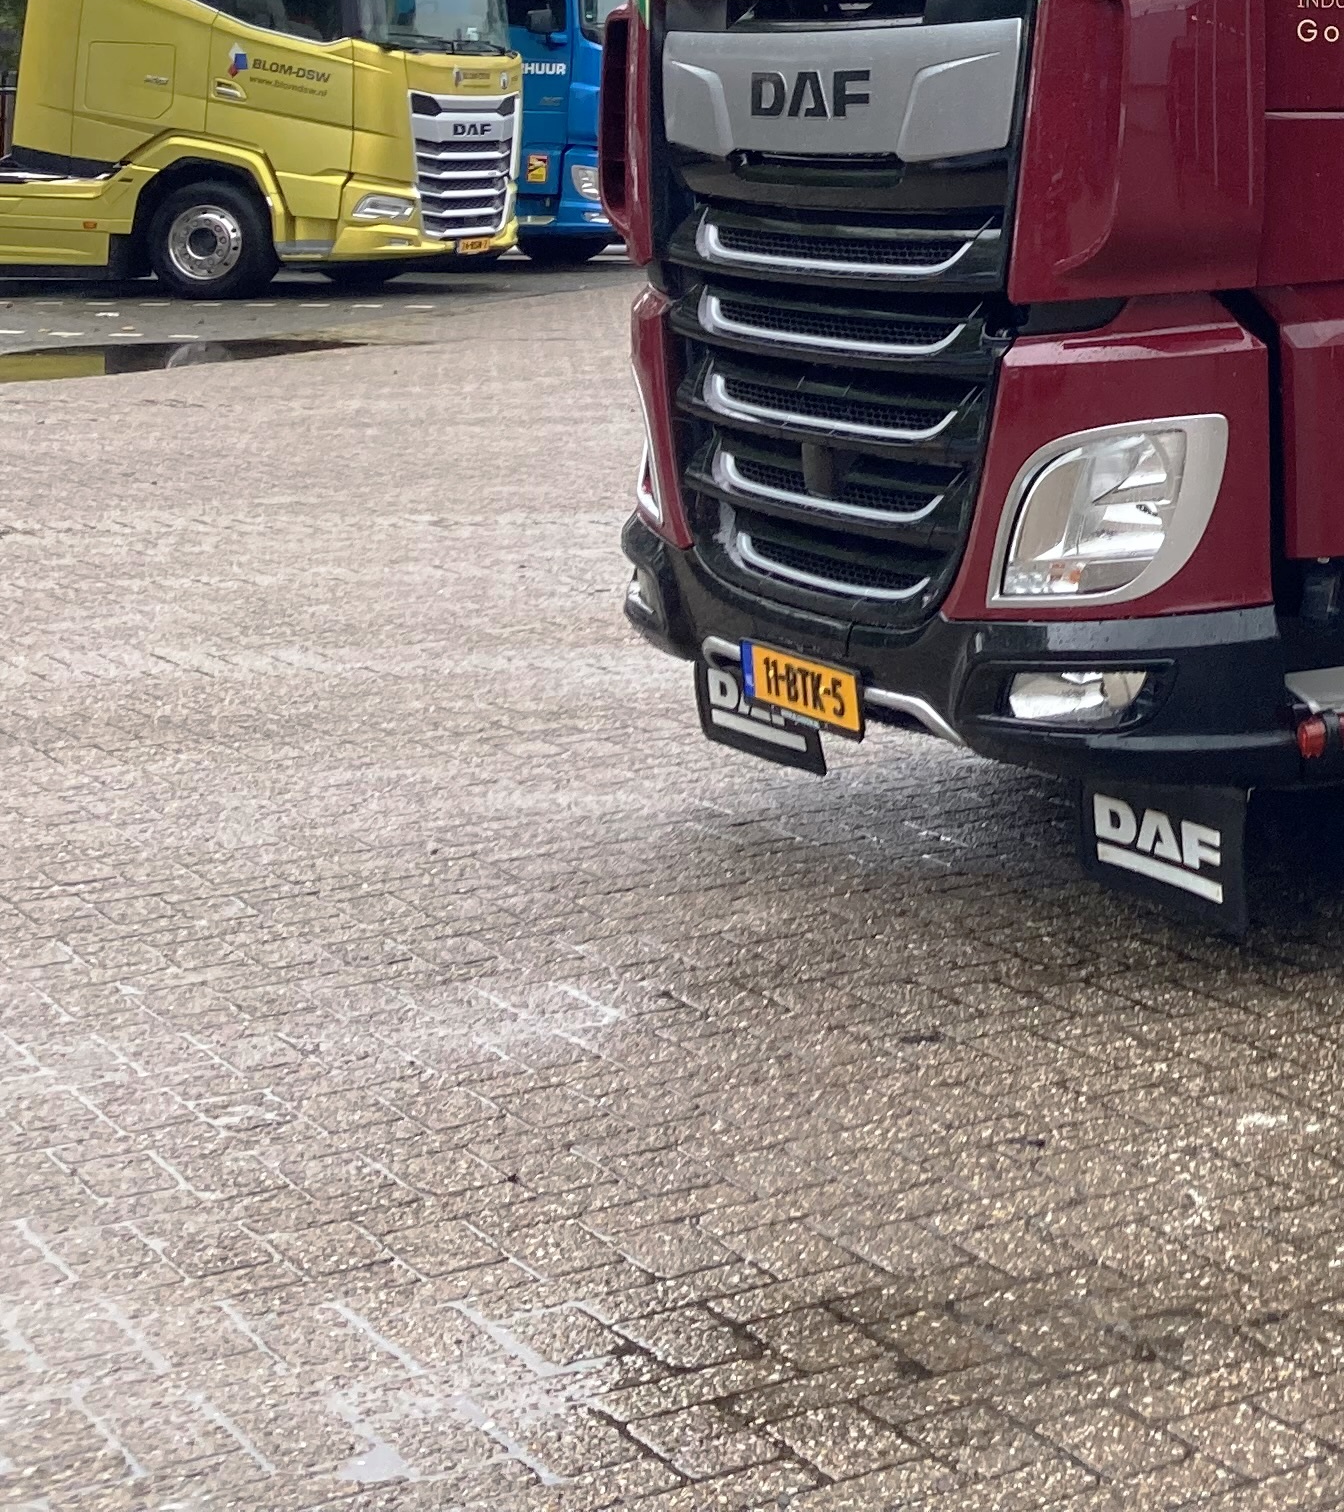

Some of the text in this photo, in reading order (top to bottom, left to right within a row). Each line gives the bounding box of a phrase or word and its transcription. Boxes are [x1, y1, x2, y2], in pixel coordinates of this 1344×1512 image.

[252, 58, 331, 83] BLOM-DSW
[750, 69, 871, 118] DAF
[453, 123, 492, 136] DAF
[763, 655, 846, 719] 11-BTK-5
[1093, 792, 1221, 870] DAF
